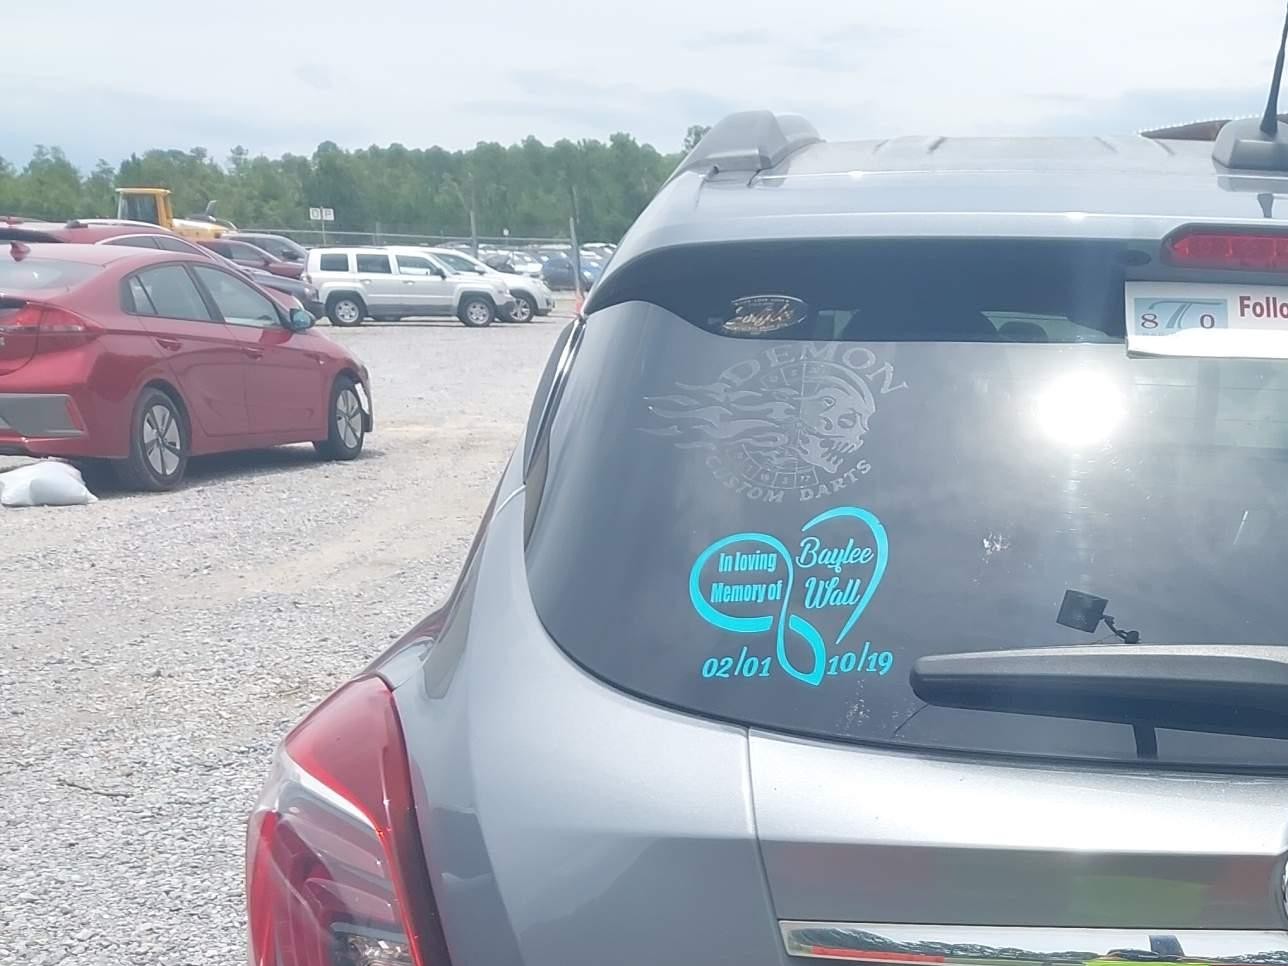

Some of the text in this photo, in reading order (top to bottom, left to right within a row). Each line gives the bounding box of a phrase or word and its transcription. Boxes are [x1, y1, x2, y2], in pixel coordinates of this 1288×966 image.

[1140, 313, 1159, 329] 8
[719, 342, 909, 395] DEMON
[705, 455, 872, 503] CUSTOM DARTS
[719, 550, 777, 572] In loving
[796, 537, 874, 573] Baylee
[711, 580, 783, 603] Memory of
[804, 576, 861, 609] Wall
[702, 646, 771, 678] 02/01
[827, 642, 893, 676] 10/19
